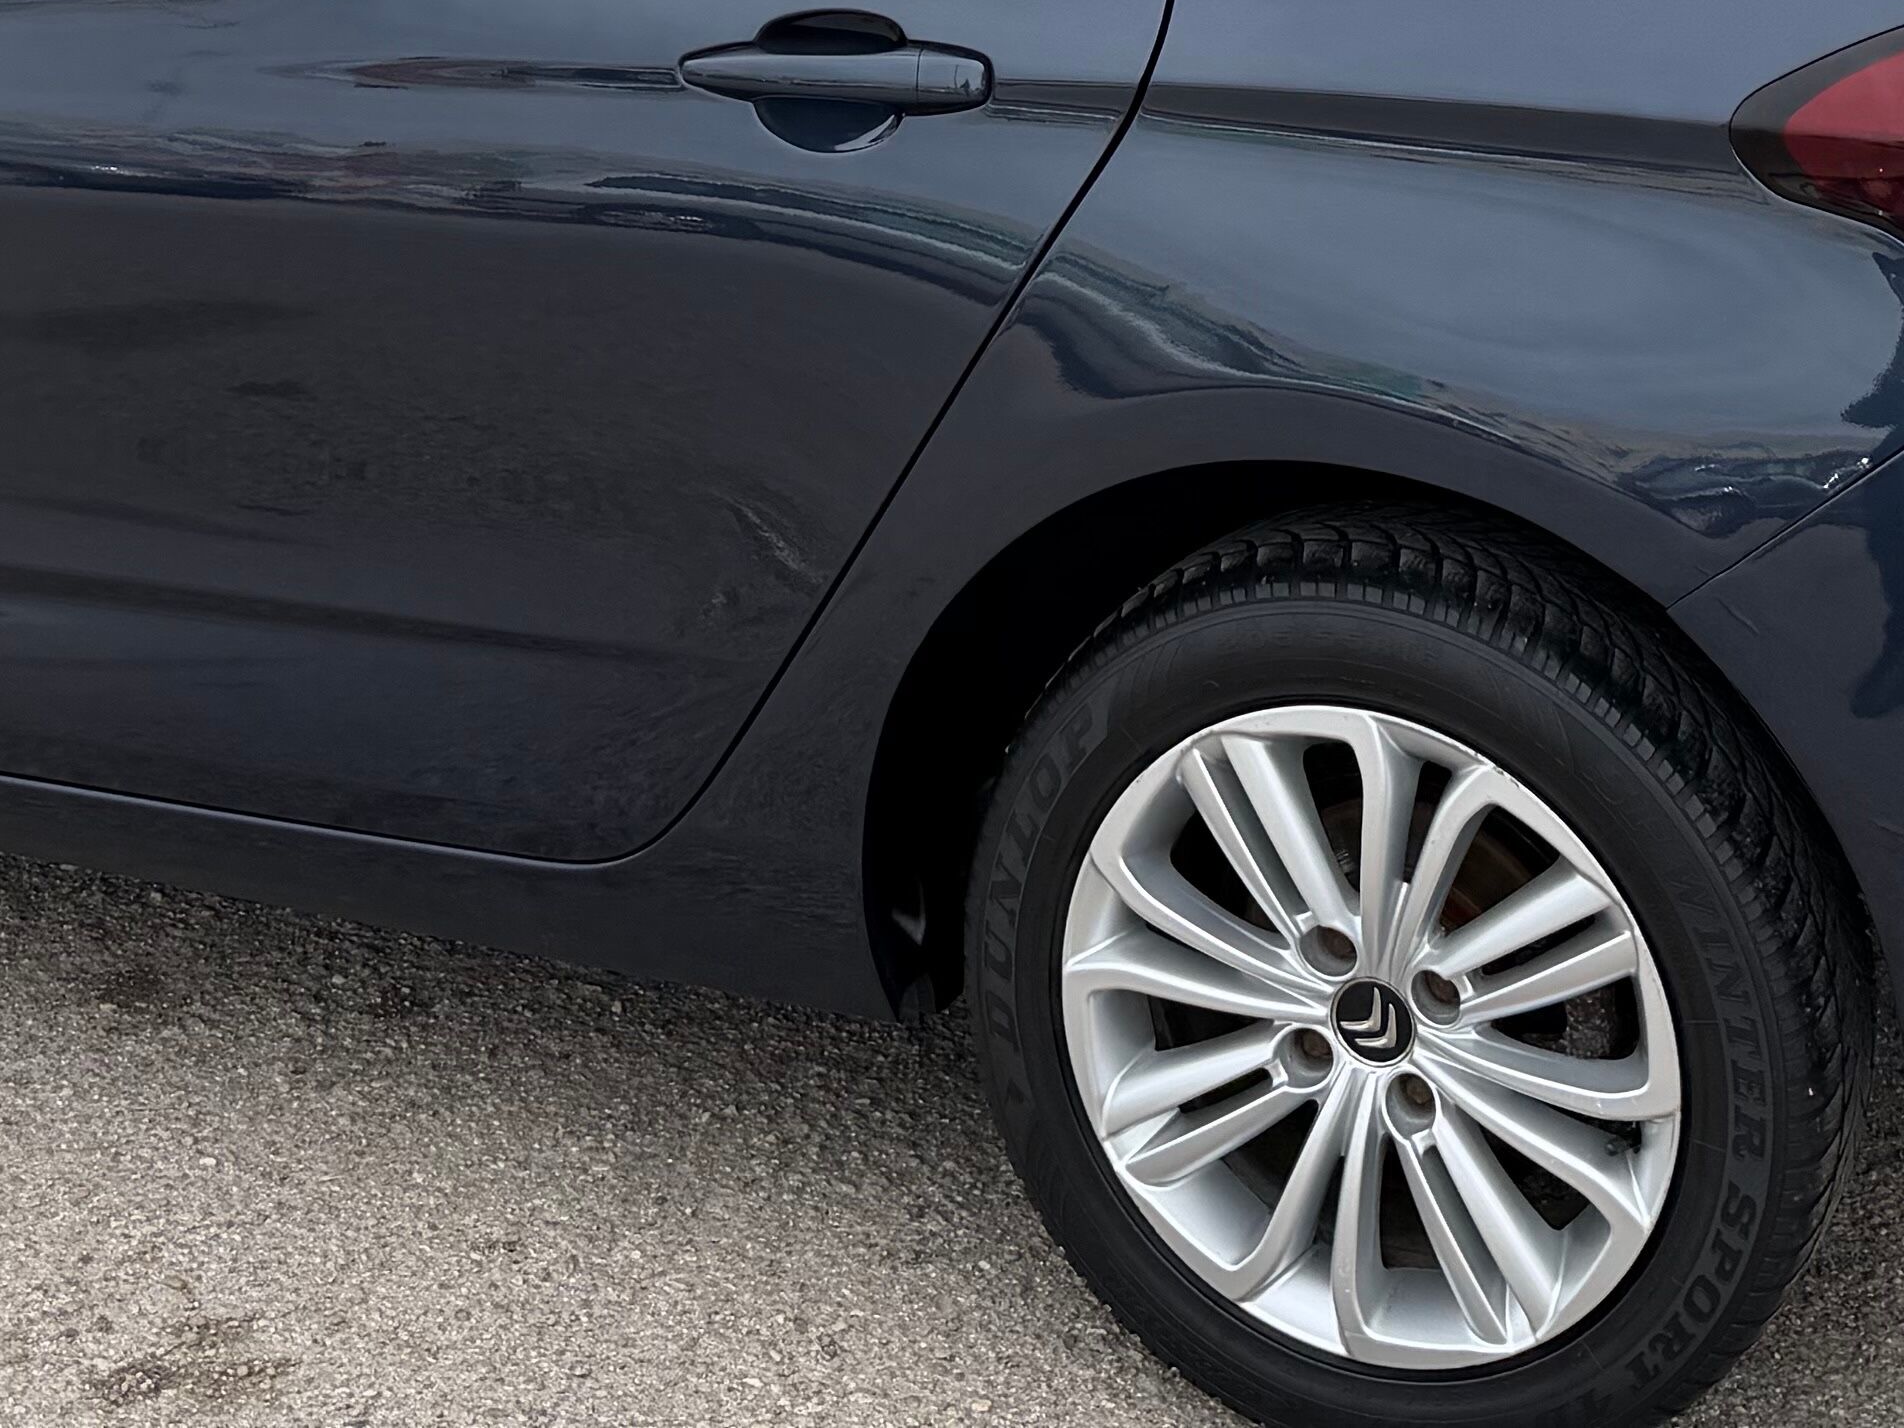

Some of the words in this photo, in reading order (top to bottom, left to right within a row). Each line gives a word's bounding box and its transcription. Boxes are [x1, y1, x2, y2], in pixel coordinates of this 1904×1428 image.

[984, 699, 1094, 1050] DUNLOP
[1672, 877, 1769, 1162] WINTER
[1625, 1179, 1757, 1394] SPORT
